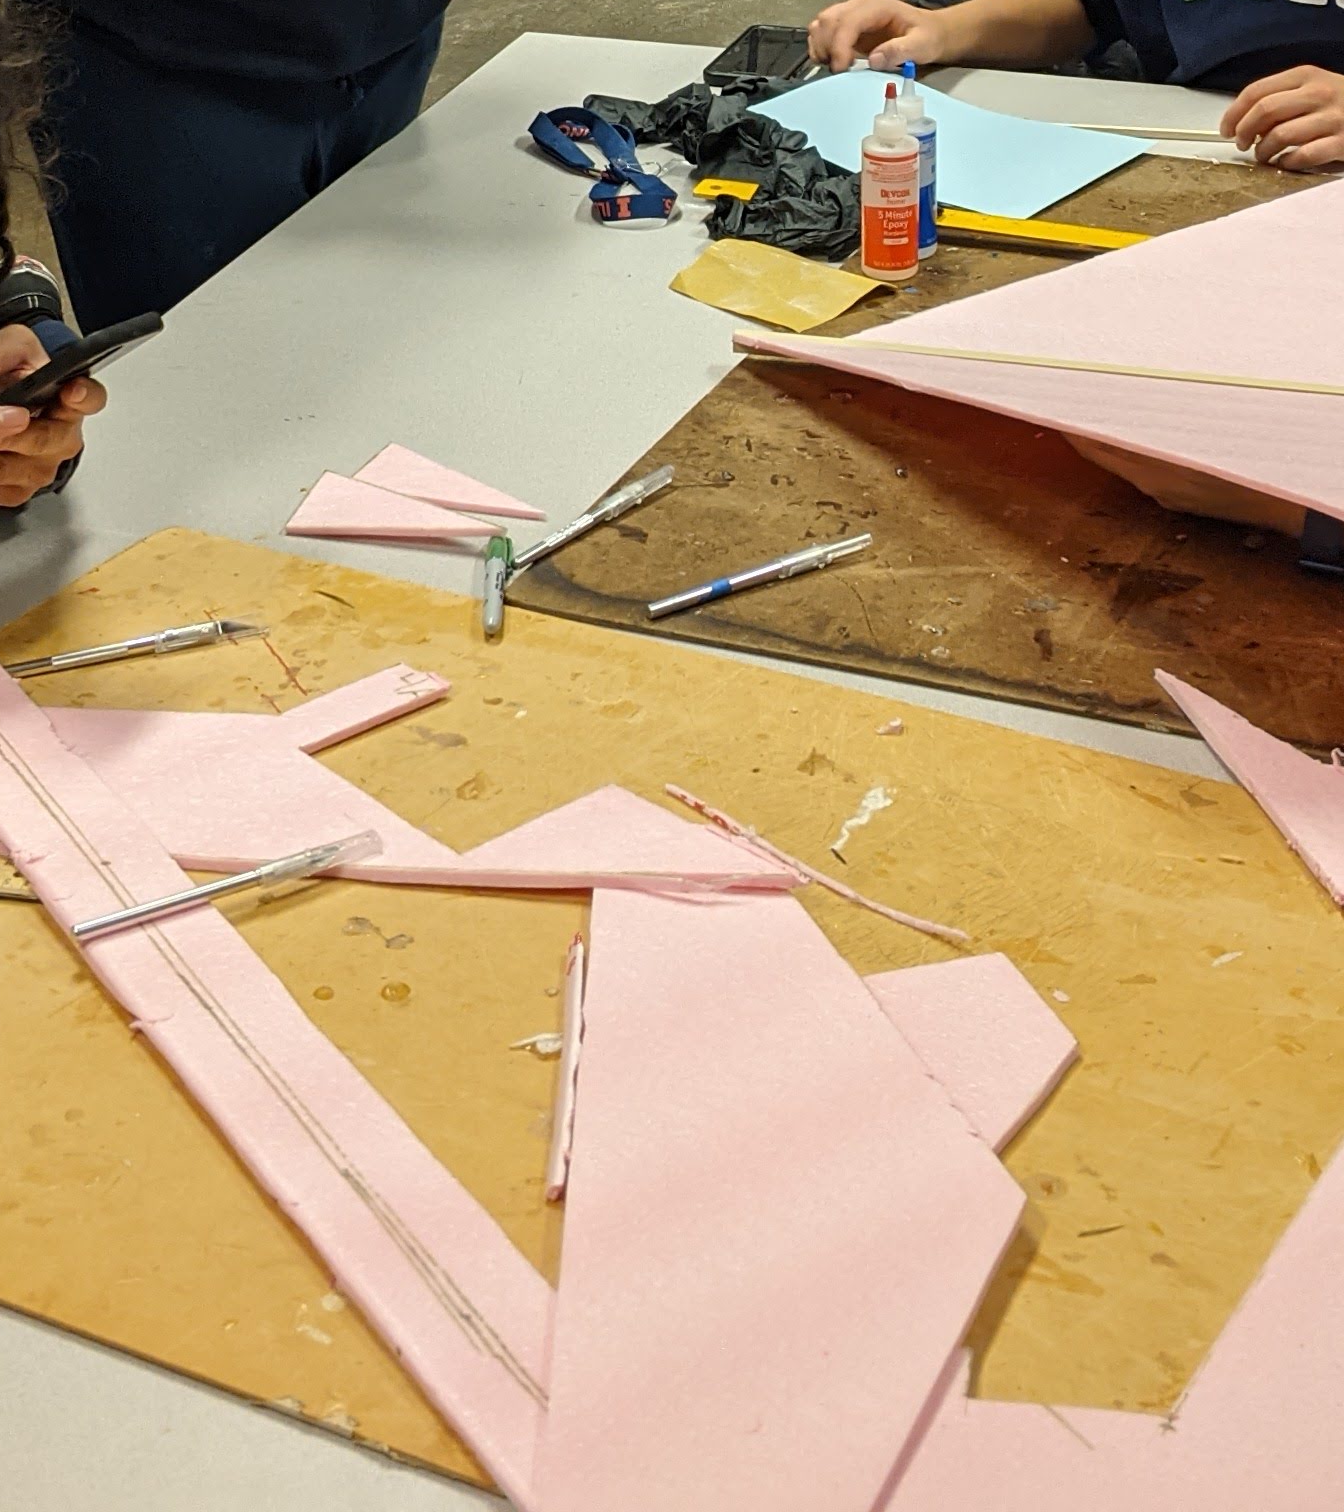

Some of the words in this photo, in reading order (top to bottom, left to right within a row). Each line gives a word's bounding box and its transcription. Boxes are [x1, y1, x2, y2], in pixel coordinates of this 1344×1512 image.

[877, 210, 884, 220] 5
[885, 209, 913, 221] Minute
[883, 219, 909, 231] Epoxy
